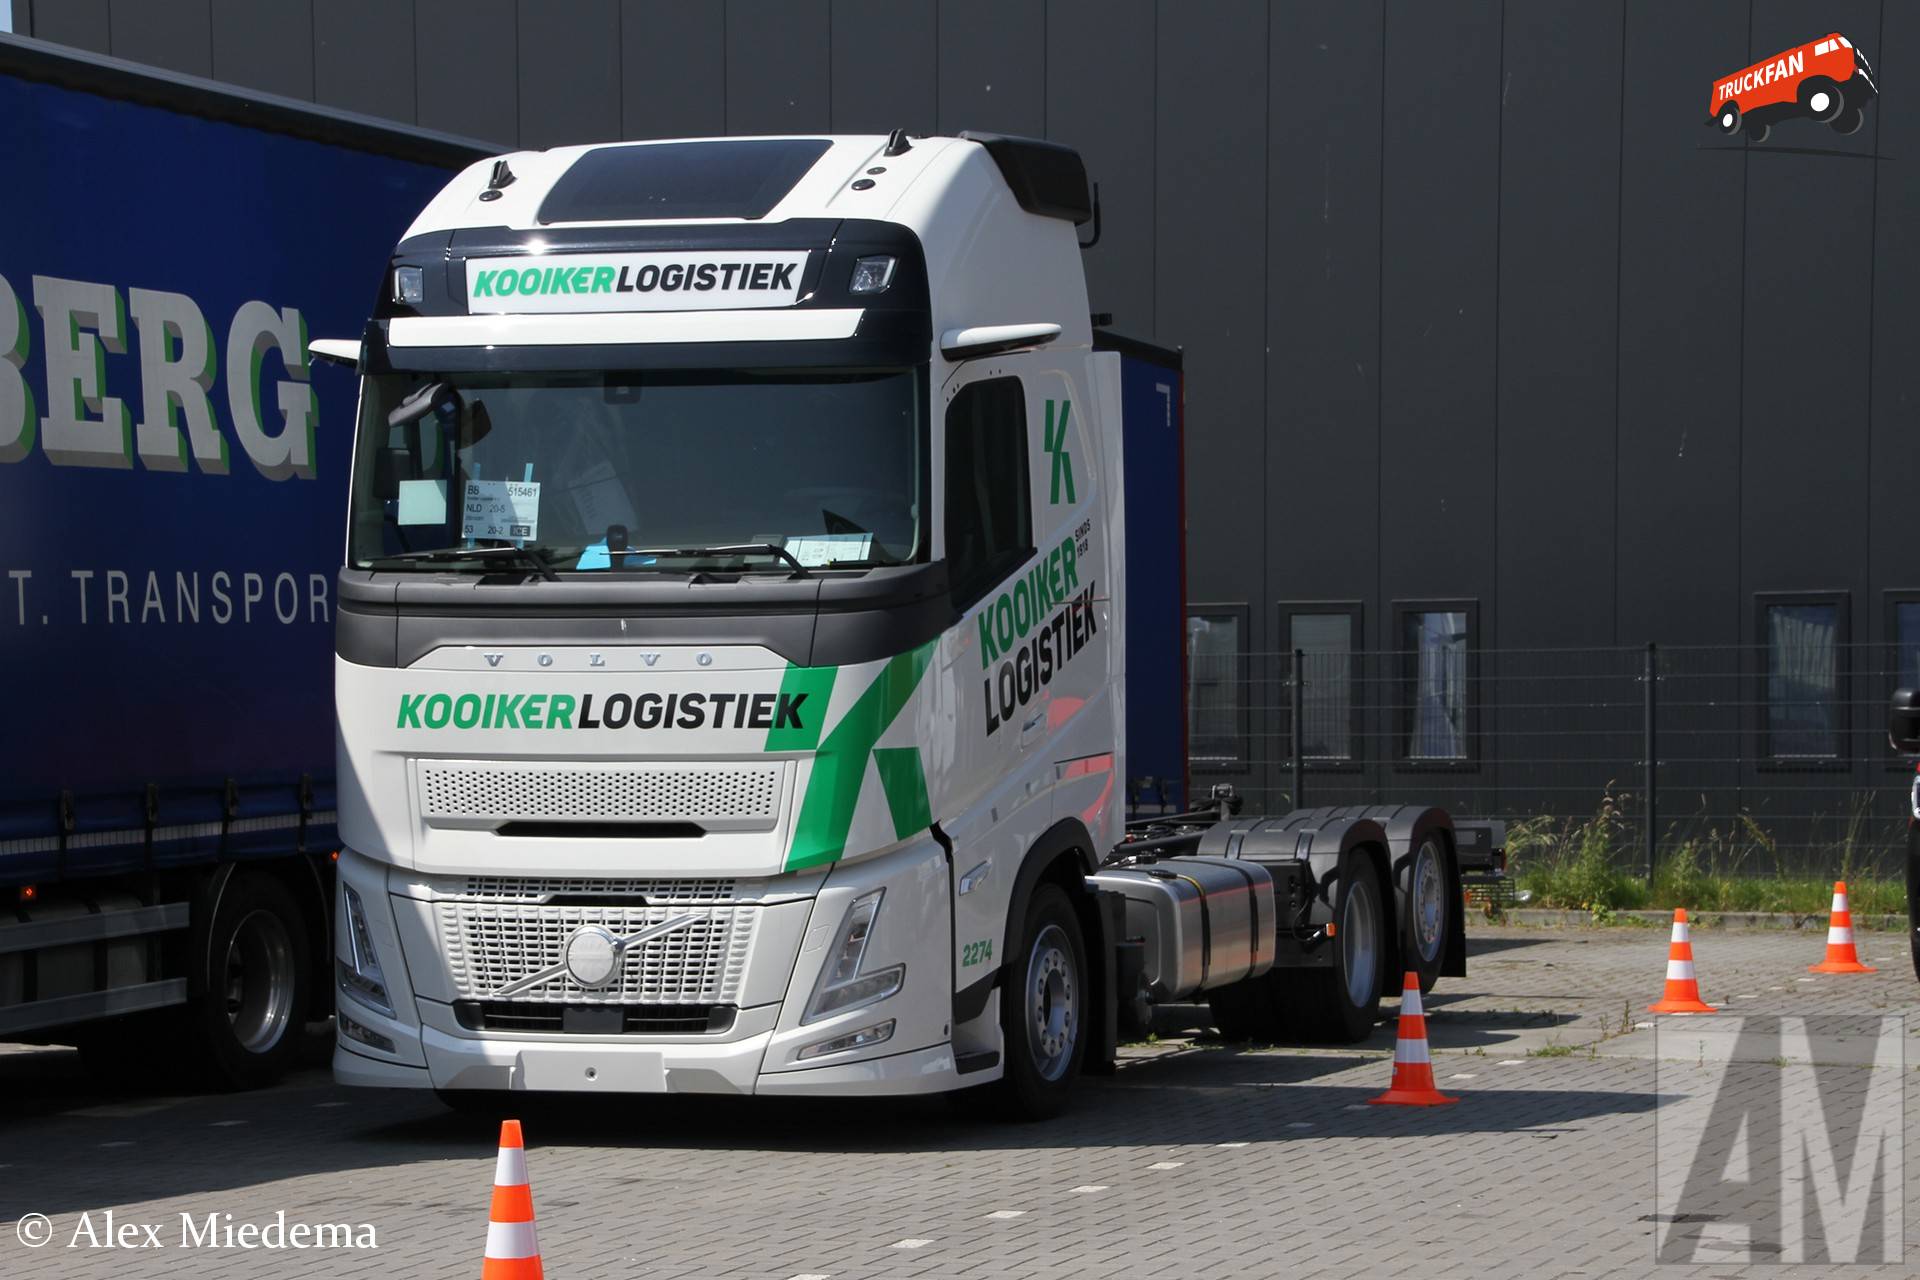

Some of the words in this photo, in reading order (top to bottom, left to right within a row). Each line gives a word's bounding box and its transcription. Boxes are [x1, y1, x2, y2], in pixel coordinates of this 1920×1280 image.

[978, 536, 1079, 671] KOOIKER
[484, 652, 713, 667] VOLVO
[983, 579, 1098, 737] LOGISTIEK
[962, 939, 993, 967] 2274
